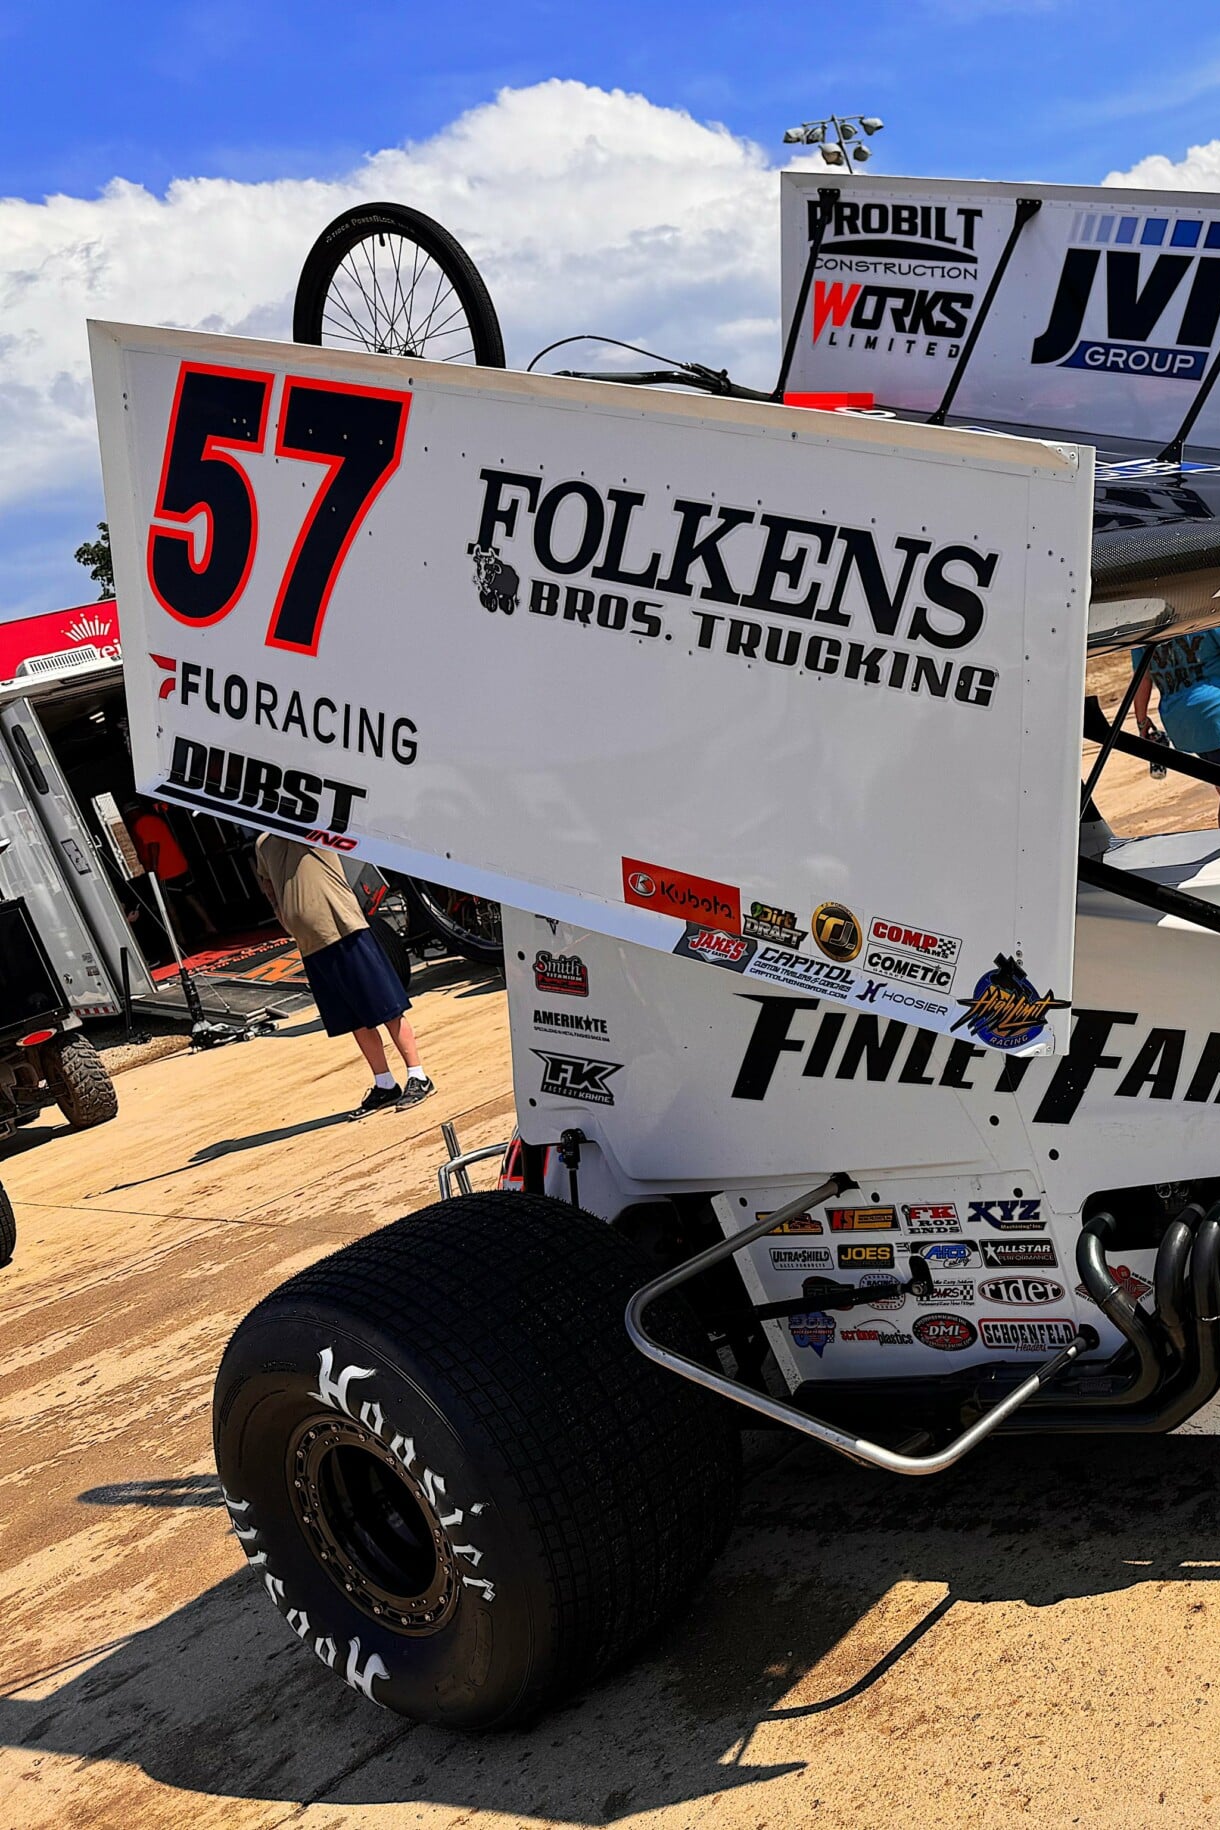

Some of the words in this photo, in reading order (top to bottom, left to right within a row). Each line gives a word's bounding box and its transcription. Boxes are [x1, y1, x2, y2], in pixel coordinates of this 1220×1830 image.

[814, 258, 978, 280] CONSTRUCTION
[813, 281, 975, 345] WORKS
[829, 332, 960, 358] LIMITED
[1084, 345, 1196, 374] GROUP
[147, 361, 412, 657] 57
[467, 468, 1000, 649] FOLKENS
[529, 579, 673, 642] BROS.
[691, 610, 998, 707] TRUCKING
[167, 736, 367, 834] DURST
[660, 880, 733, 919] Kubota
[760, 904, 793, 928] Dirt
[744, 917, 802, 945] DRAFT
[873, 921, 938, 950] COMP
[535, 952, 582, 976] Smith
[916, 946, 949, 959] CAMS
[758, 947, 855, 985] CAPITOL
[881, 990, 948, 1016] HOOSIER
[990, 1034, 1029, 1047] RACING
[910, 1206, 956, 1219] FK
[967, 1200, 1041, 1226] XYZ
[908, 1226, 960, 1234] ENDS
[841, 1247, 891, 1260] JOES
[997, 1244, 1052, 1253] ALLSTAR
[983, 1279, 1058, 1302] rider
[928, 1325, 960, 1336] DMI
[983, 1323, 1075, 1345] SCHOENFELD
